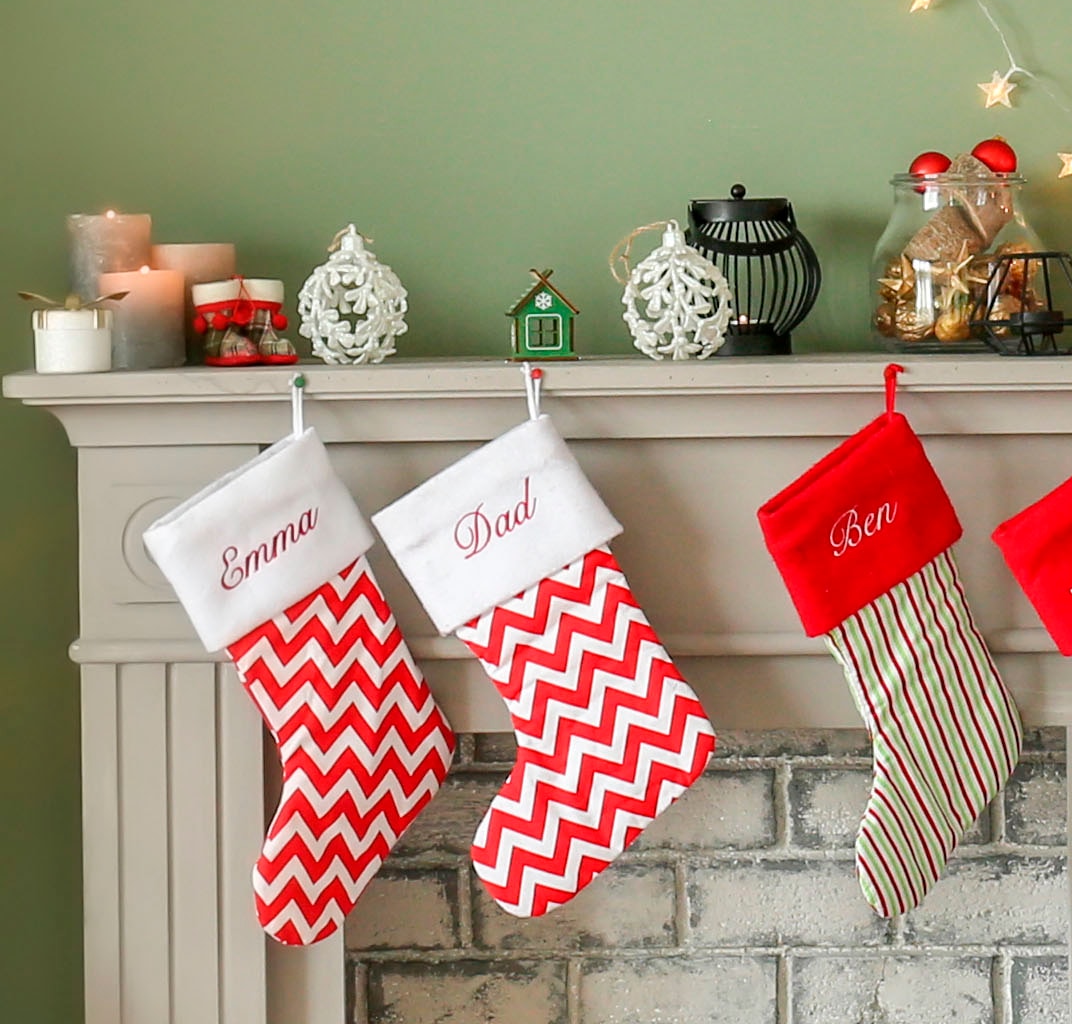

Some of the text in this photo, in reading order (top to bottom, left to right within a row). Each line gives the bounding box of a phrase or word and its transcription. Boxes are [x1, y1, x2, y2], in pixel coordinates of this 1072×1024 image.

[219, 505, 320, 591] Emma
[453, 475, 538, 560] Dad
[828, 500, 898, 557] Ben
